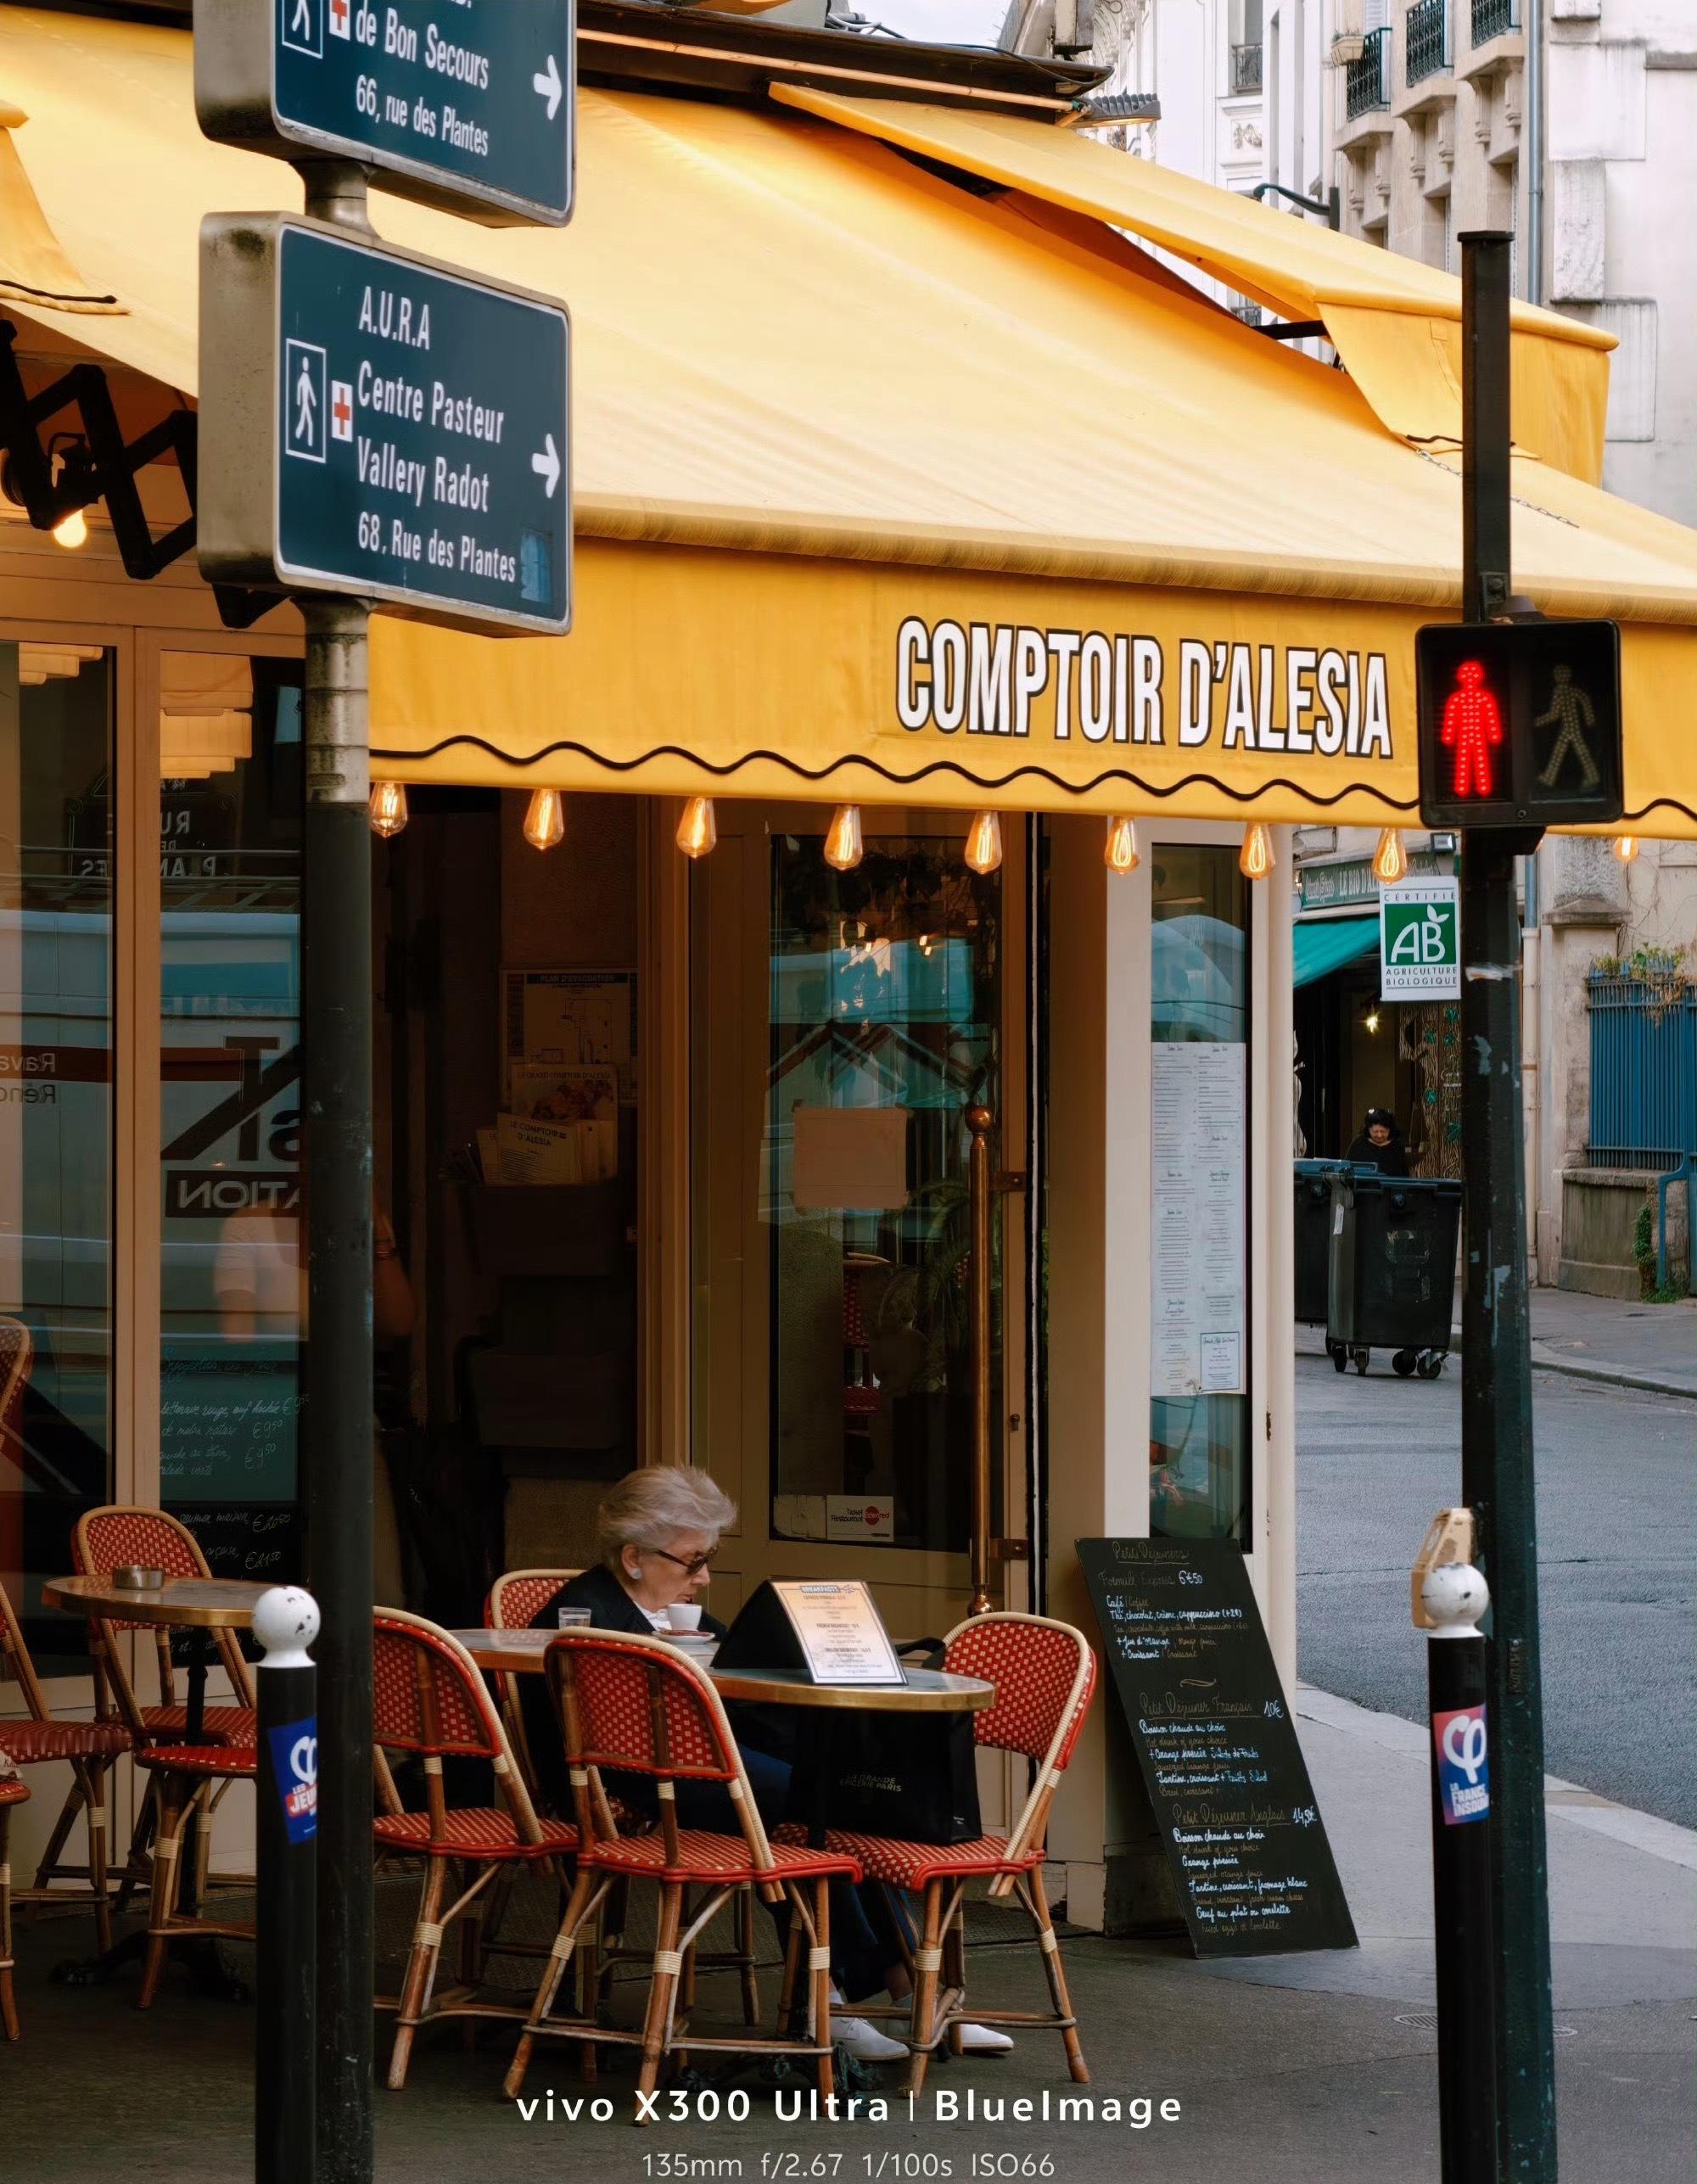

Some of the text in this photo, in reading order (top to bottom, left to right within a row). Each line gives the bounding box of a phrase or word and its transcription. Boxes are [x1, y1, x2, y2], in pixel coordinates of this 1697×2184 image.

[356, 8, 489, 90] de Bon Secours
[356, 75, 488, 156] 66, rue des Plantes
[358, 286, 430, 350] A.U.R.A
[358, 361, 504, 444] Centre Pasteur
[358, 435, 489, 512] Vallery Radot
[392, 519, 421, 560] Rue
[428, 528, 454, 569] des
[460, 535, 516, 582] Plantes
[896, 615, 1392, 759] COMPTOIR D'ALESIA
[1386, 966, 1457, 975] AGRICULTURE
[1391, 921, 1445, 963] AB
[1386, 977, 1457, 986] BIOLOGIQUE
[519, 1123, 557, 1138] COMPTOIR
